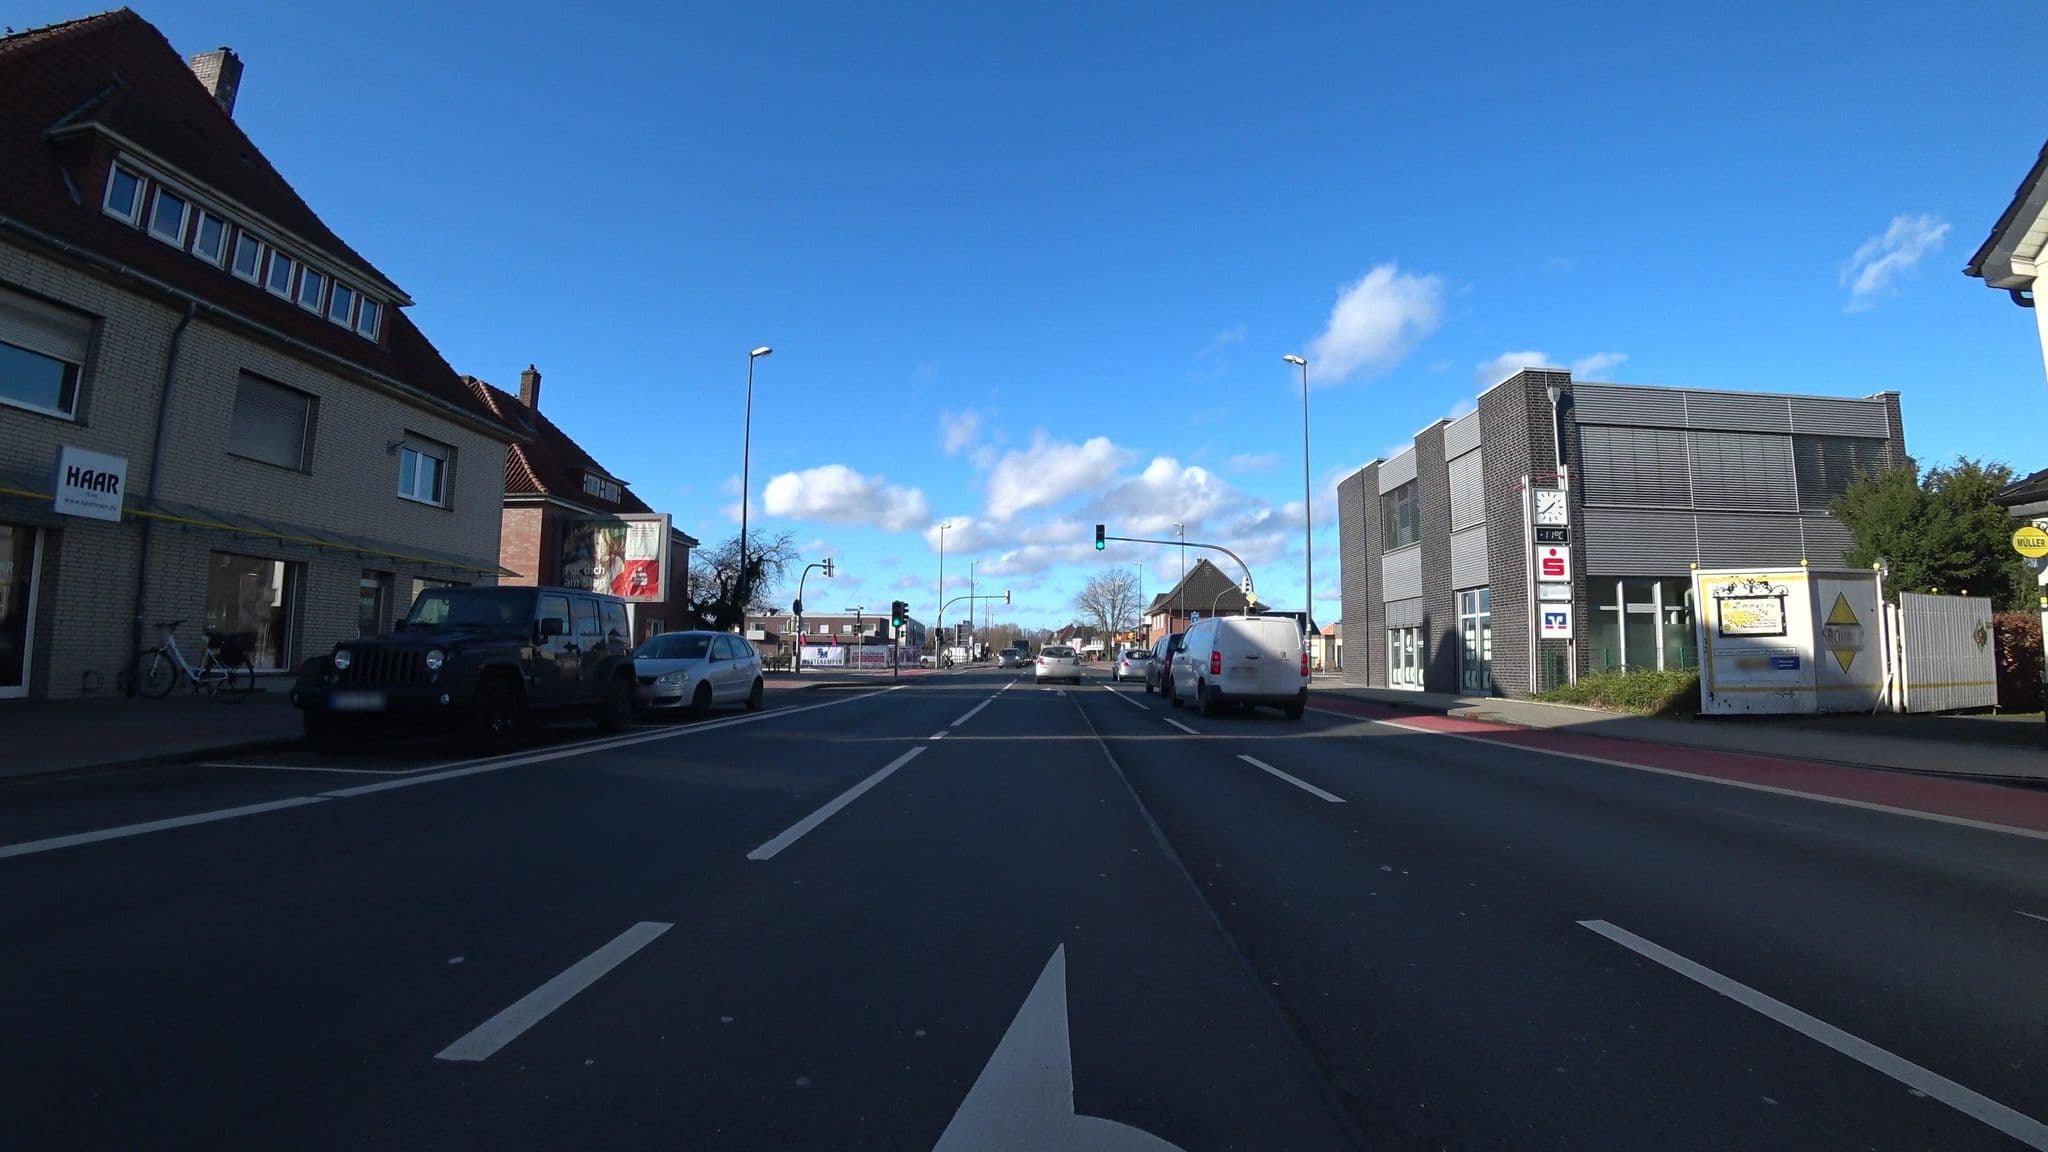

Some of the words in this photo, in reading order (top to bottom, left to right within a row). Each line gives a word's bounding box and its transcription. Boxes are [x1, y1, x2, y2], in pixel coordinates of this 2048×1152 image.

[66, 465, 120, 495] HAAR
[2016, 536, 2046, 548] MÜLLER
[584, 564, 606, 575] dich
